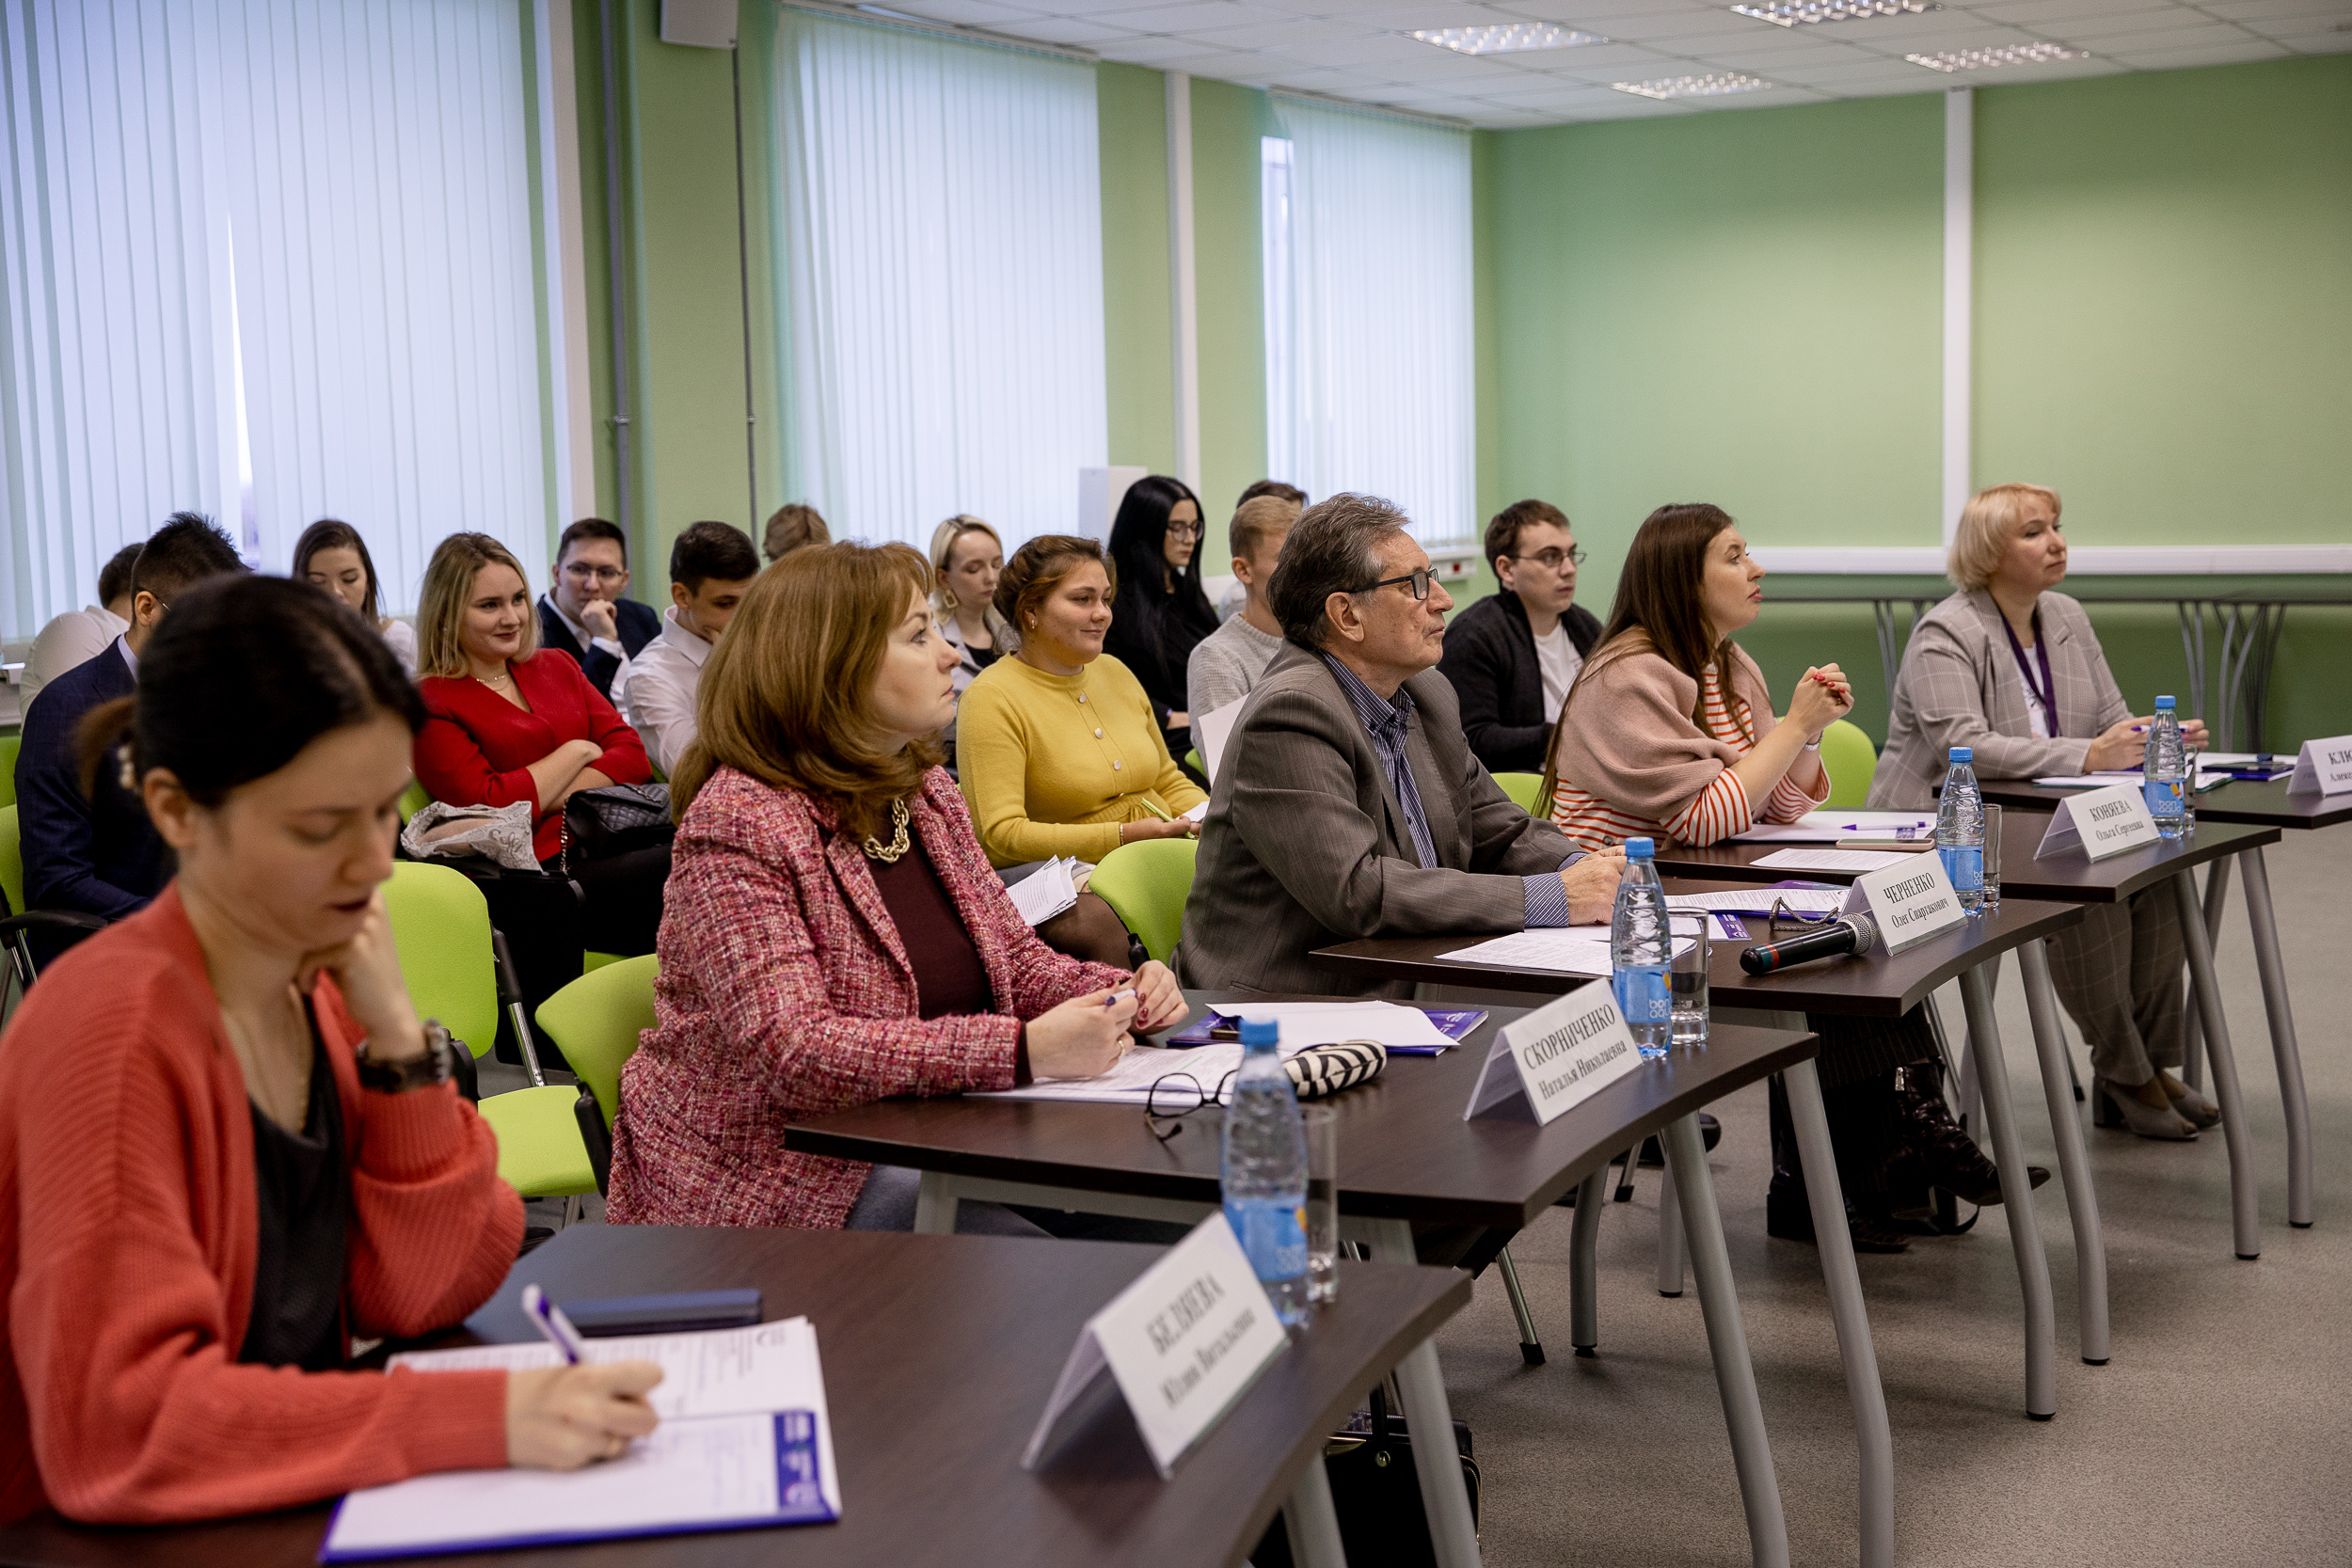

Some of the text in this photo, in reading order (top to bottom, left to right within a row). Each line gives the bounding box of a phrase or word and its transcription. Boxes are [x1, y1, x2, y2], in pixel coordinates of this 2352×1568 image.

[2089, 800, 2133, 822] КОНЯЕВА
[2095, 829, 2117, 841] Ольга
[1883, 872, 1936, 905] ЧЕРНЕНКО
[1891, 897, 1949, 928] Олег Спартакович
[1523, 1004, 1616, 1070] СКОРНИЧЕНКО
[1538, 1039, 1628, 1101] Наталья Николаевна
